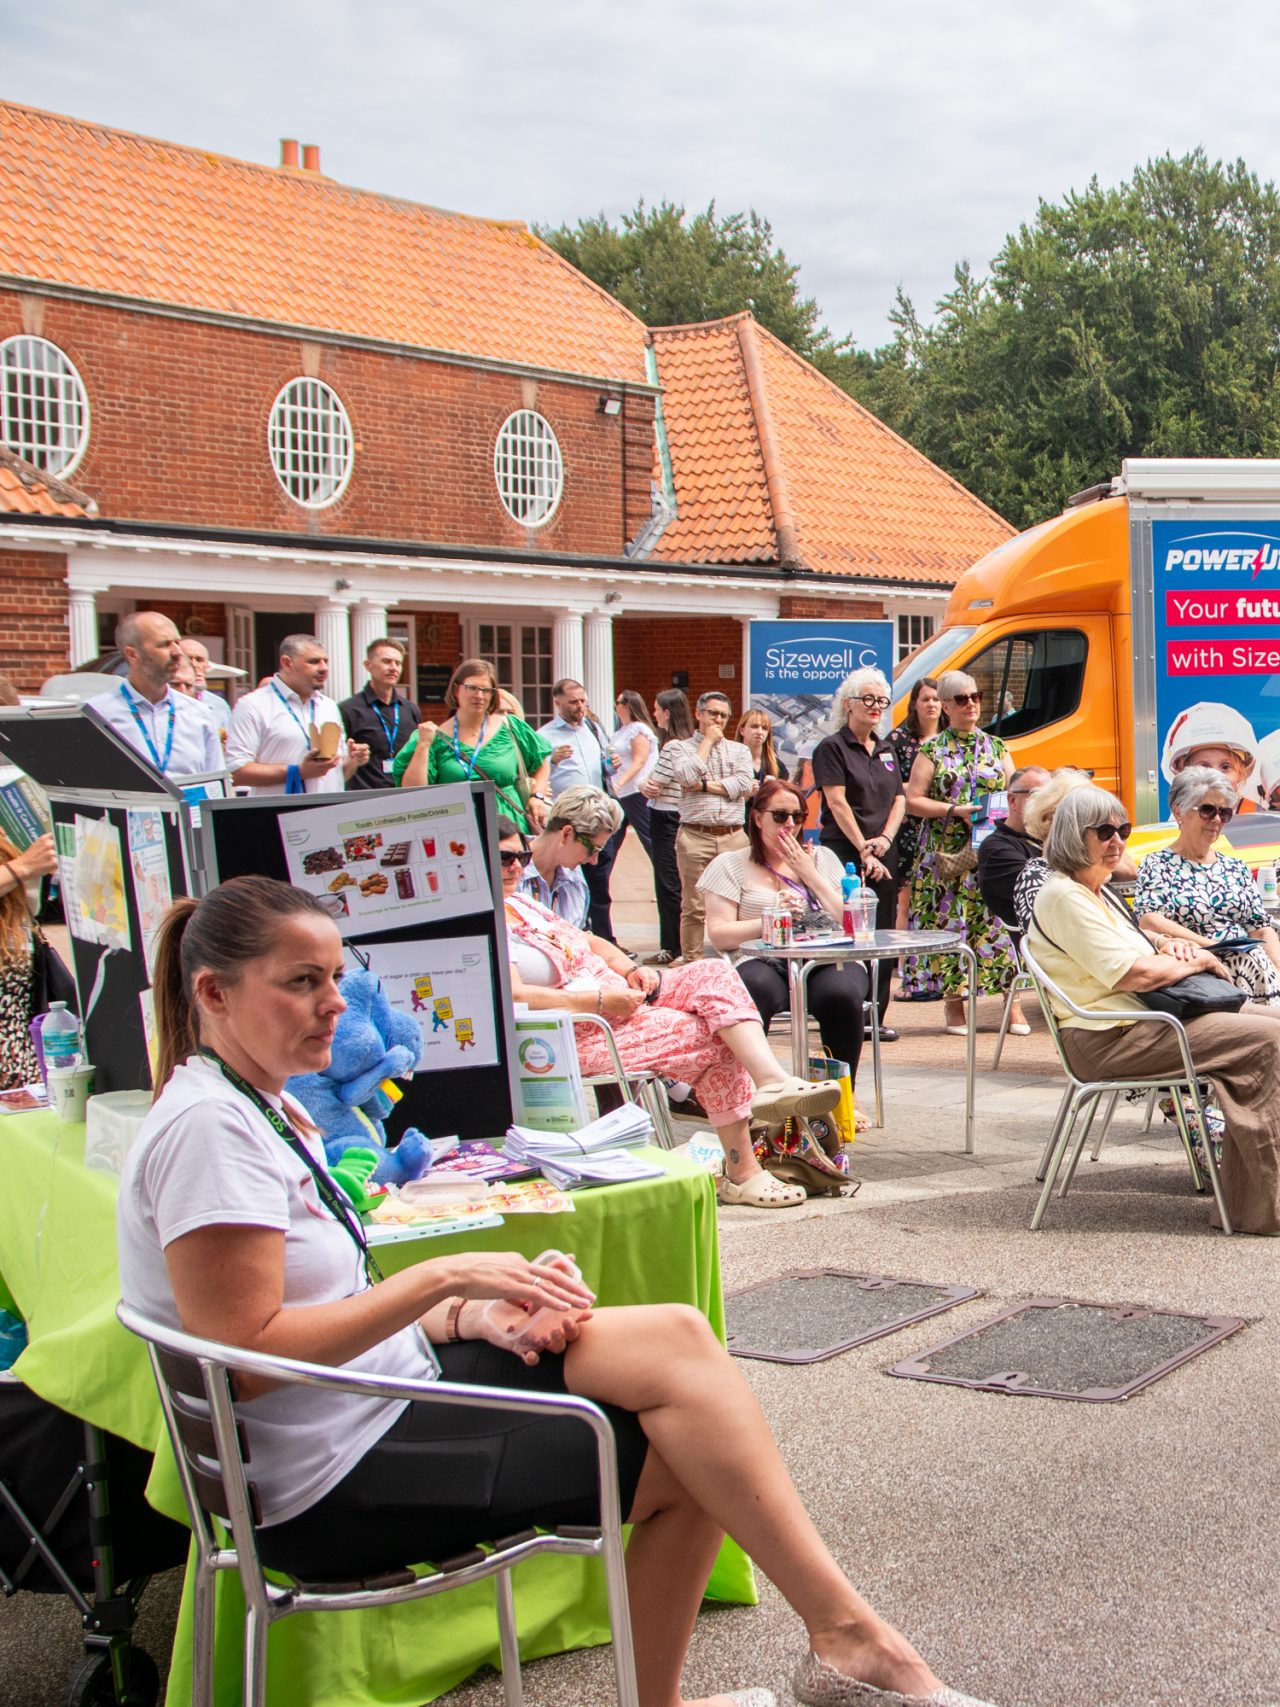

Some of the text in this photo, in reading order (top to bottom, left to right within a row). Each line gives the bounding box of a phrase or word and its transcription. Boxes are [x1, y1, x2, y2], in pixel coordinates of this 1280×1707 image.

[1173, 598, 1229, 619] Your
[765, 649, 877, 668] Sizewell C
[1172, 647, 1224, 668] with
[765, 668, 850, 681] is the opport
[374, 815, 406, 826] Unfriendly
[408, 808, 449, 820] Foods/Drinks
[265, 1107, 288, 1133] CDS
